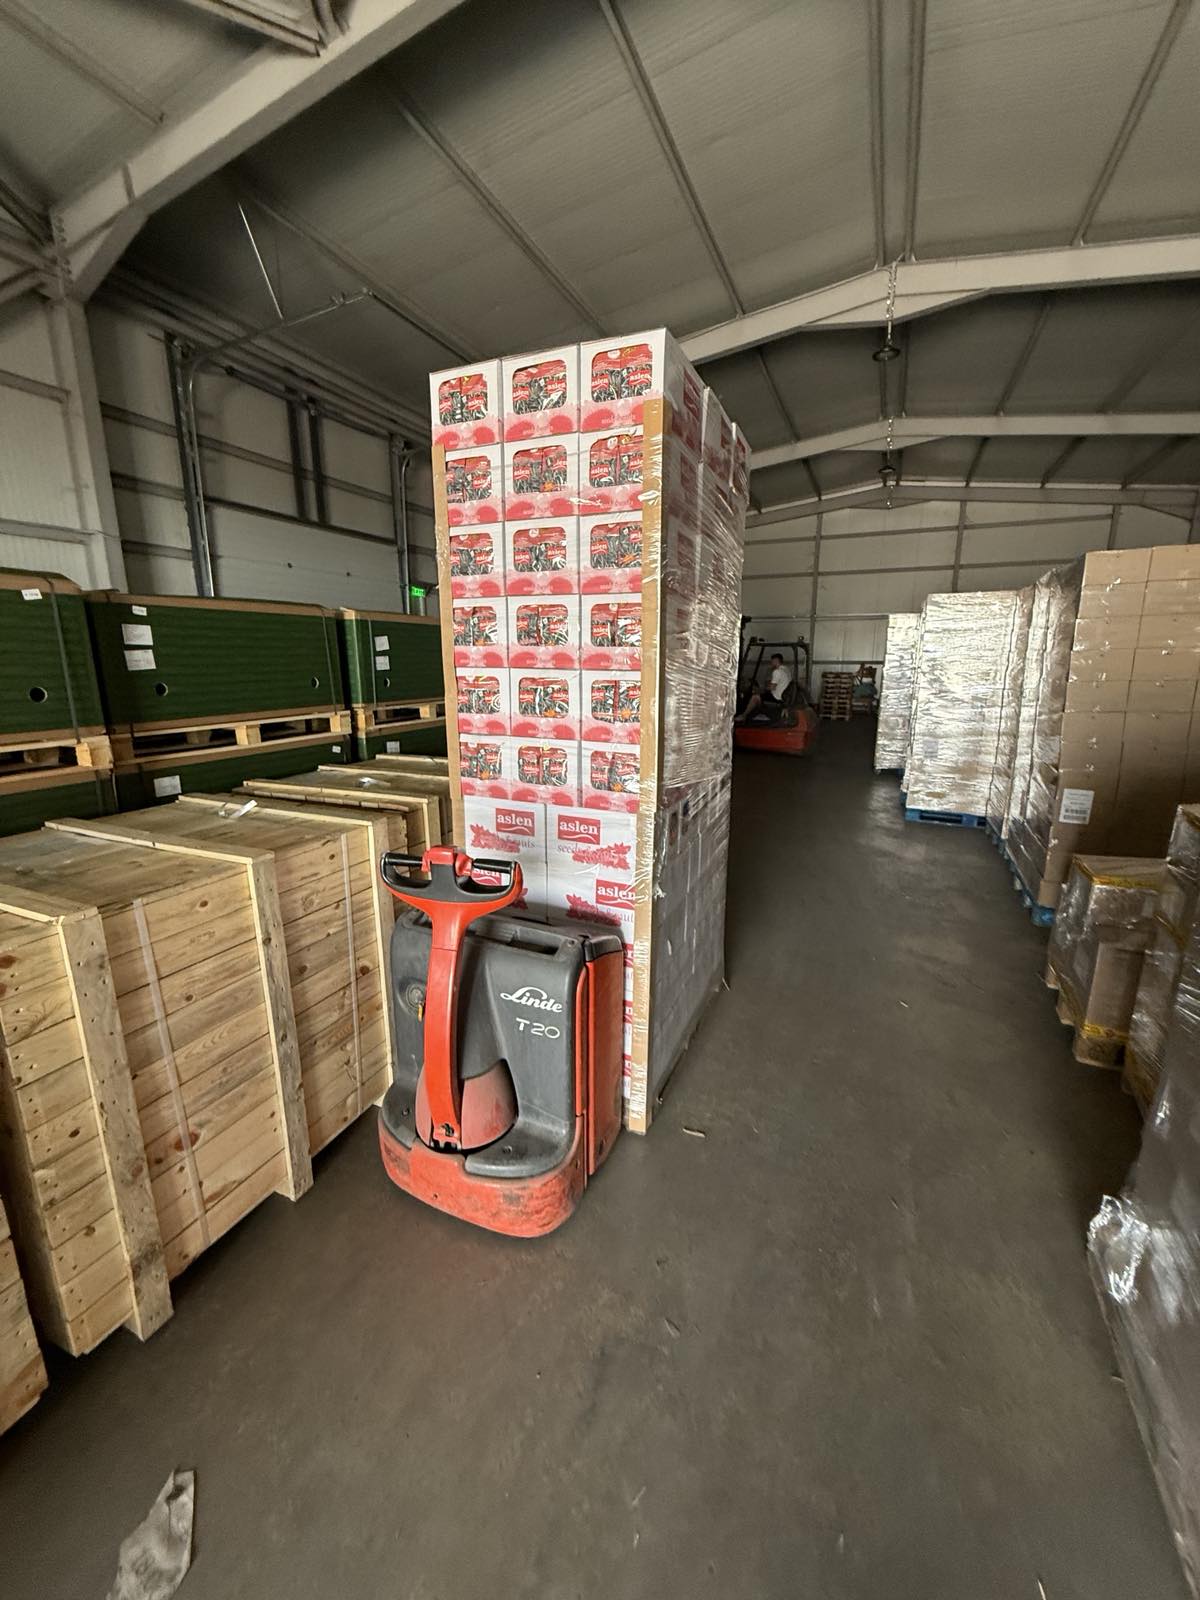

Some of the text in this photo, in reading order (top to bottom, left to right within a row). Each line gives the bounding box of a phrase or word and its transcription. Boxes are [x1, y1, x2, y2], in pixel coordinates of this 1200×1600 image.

[497, 813, 533, 827] aslen
[559, 820, 599, 835] aslen
[597, 886, 636, 900] aslen
[500, 986, 563, 1013] Linde
